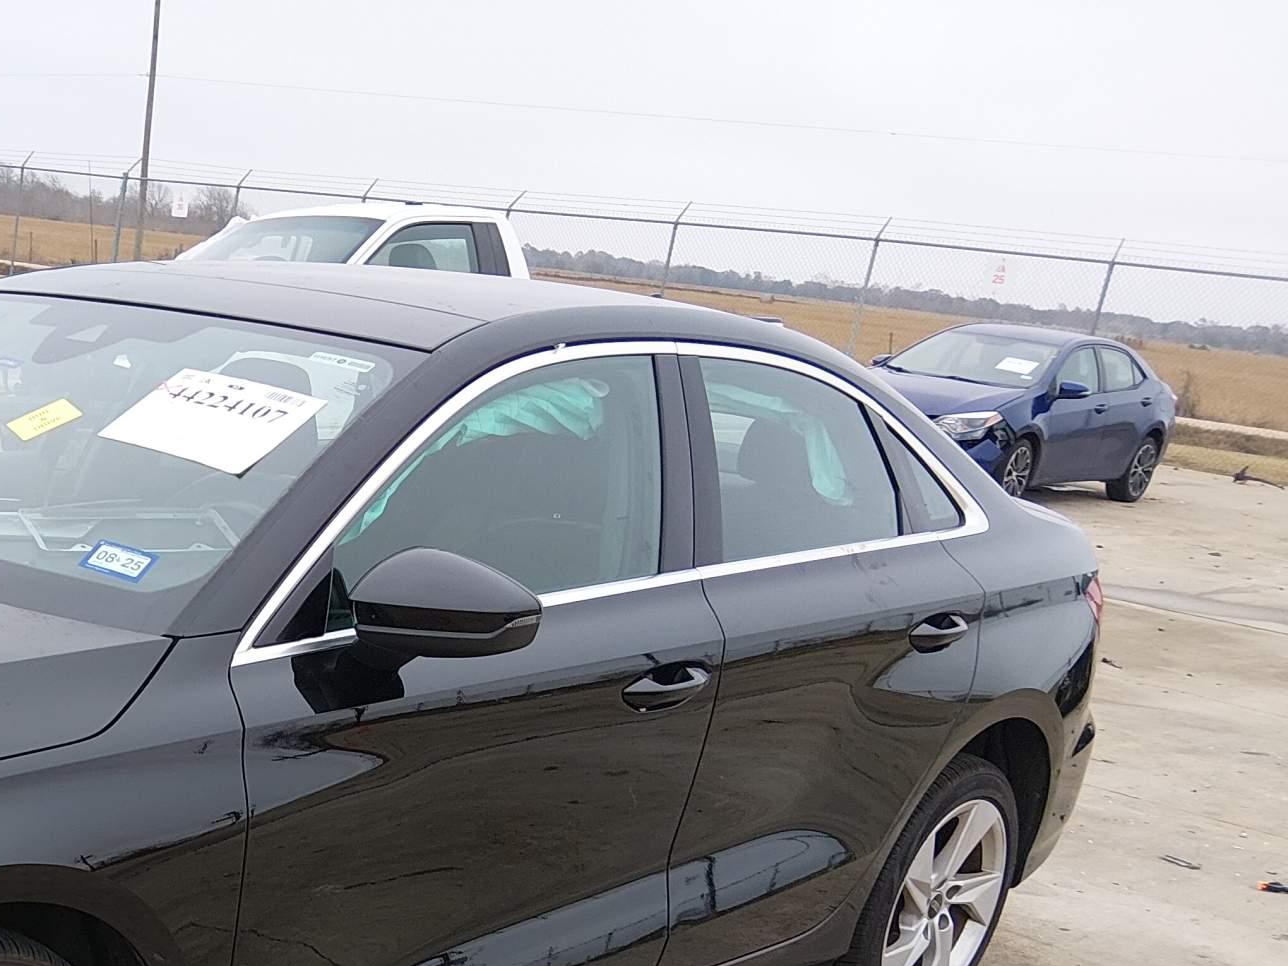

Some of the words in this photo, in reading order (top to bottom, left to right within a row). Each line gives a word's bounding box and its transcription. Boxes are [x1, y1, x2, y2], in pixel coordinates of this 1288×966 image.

[168, 387, 289, 424] 44224107
[95, 550, 118, 564] 08
[120, 557, 145, 571] 25
